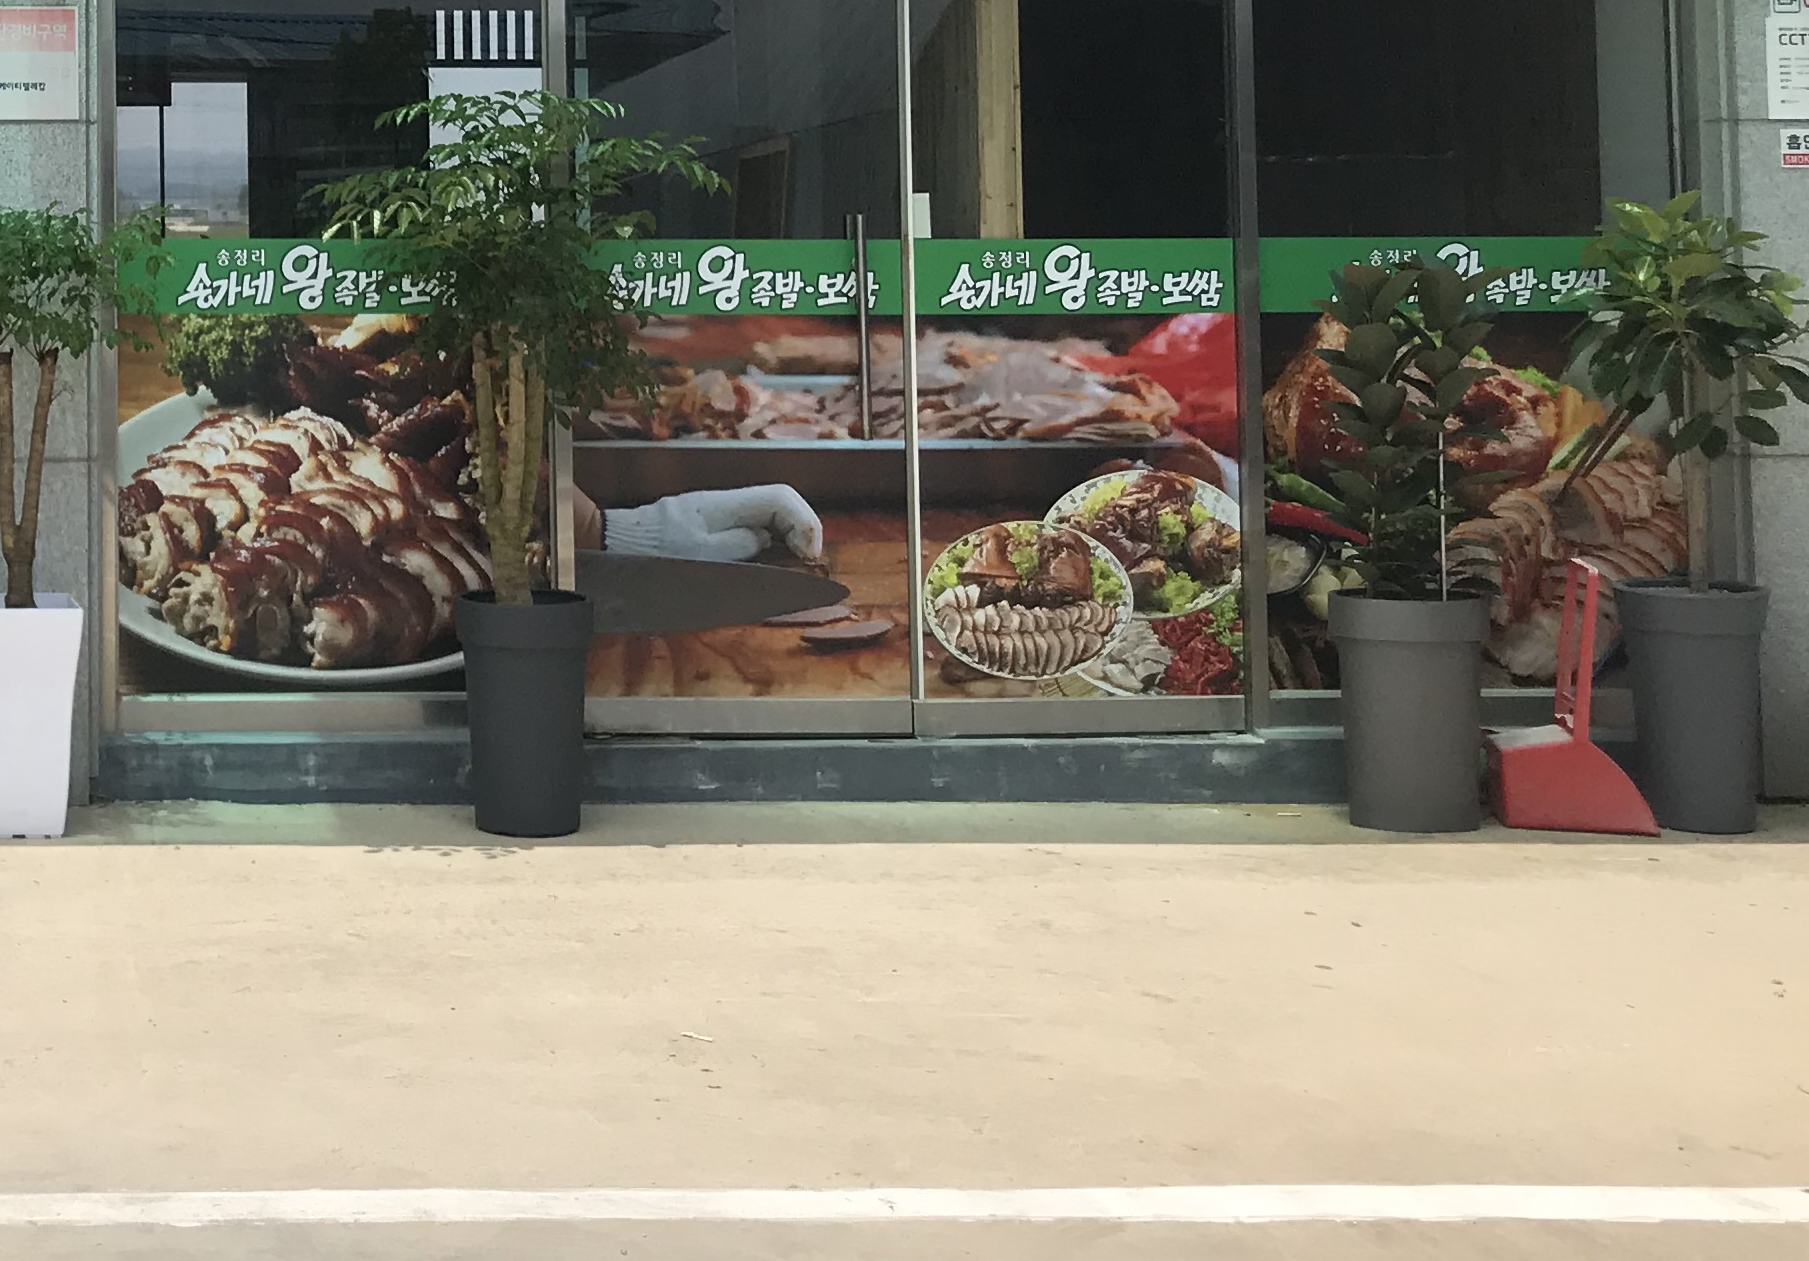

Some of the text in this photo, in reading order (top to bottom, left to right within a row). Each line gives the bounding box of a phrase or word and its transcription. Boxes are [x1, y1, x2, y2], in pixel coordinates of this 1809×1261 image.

[1778, 33, 1809, 45] CCT
[216, 248, 266, 266] 송정리
[632, 251, 682, 269] 송정리
[981, 251, 1031, 269] 송정리
[177, 262, 275, 309] 송가네
[941, 263, 1038, 310] 송가네
